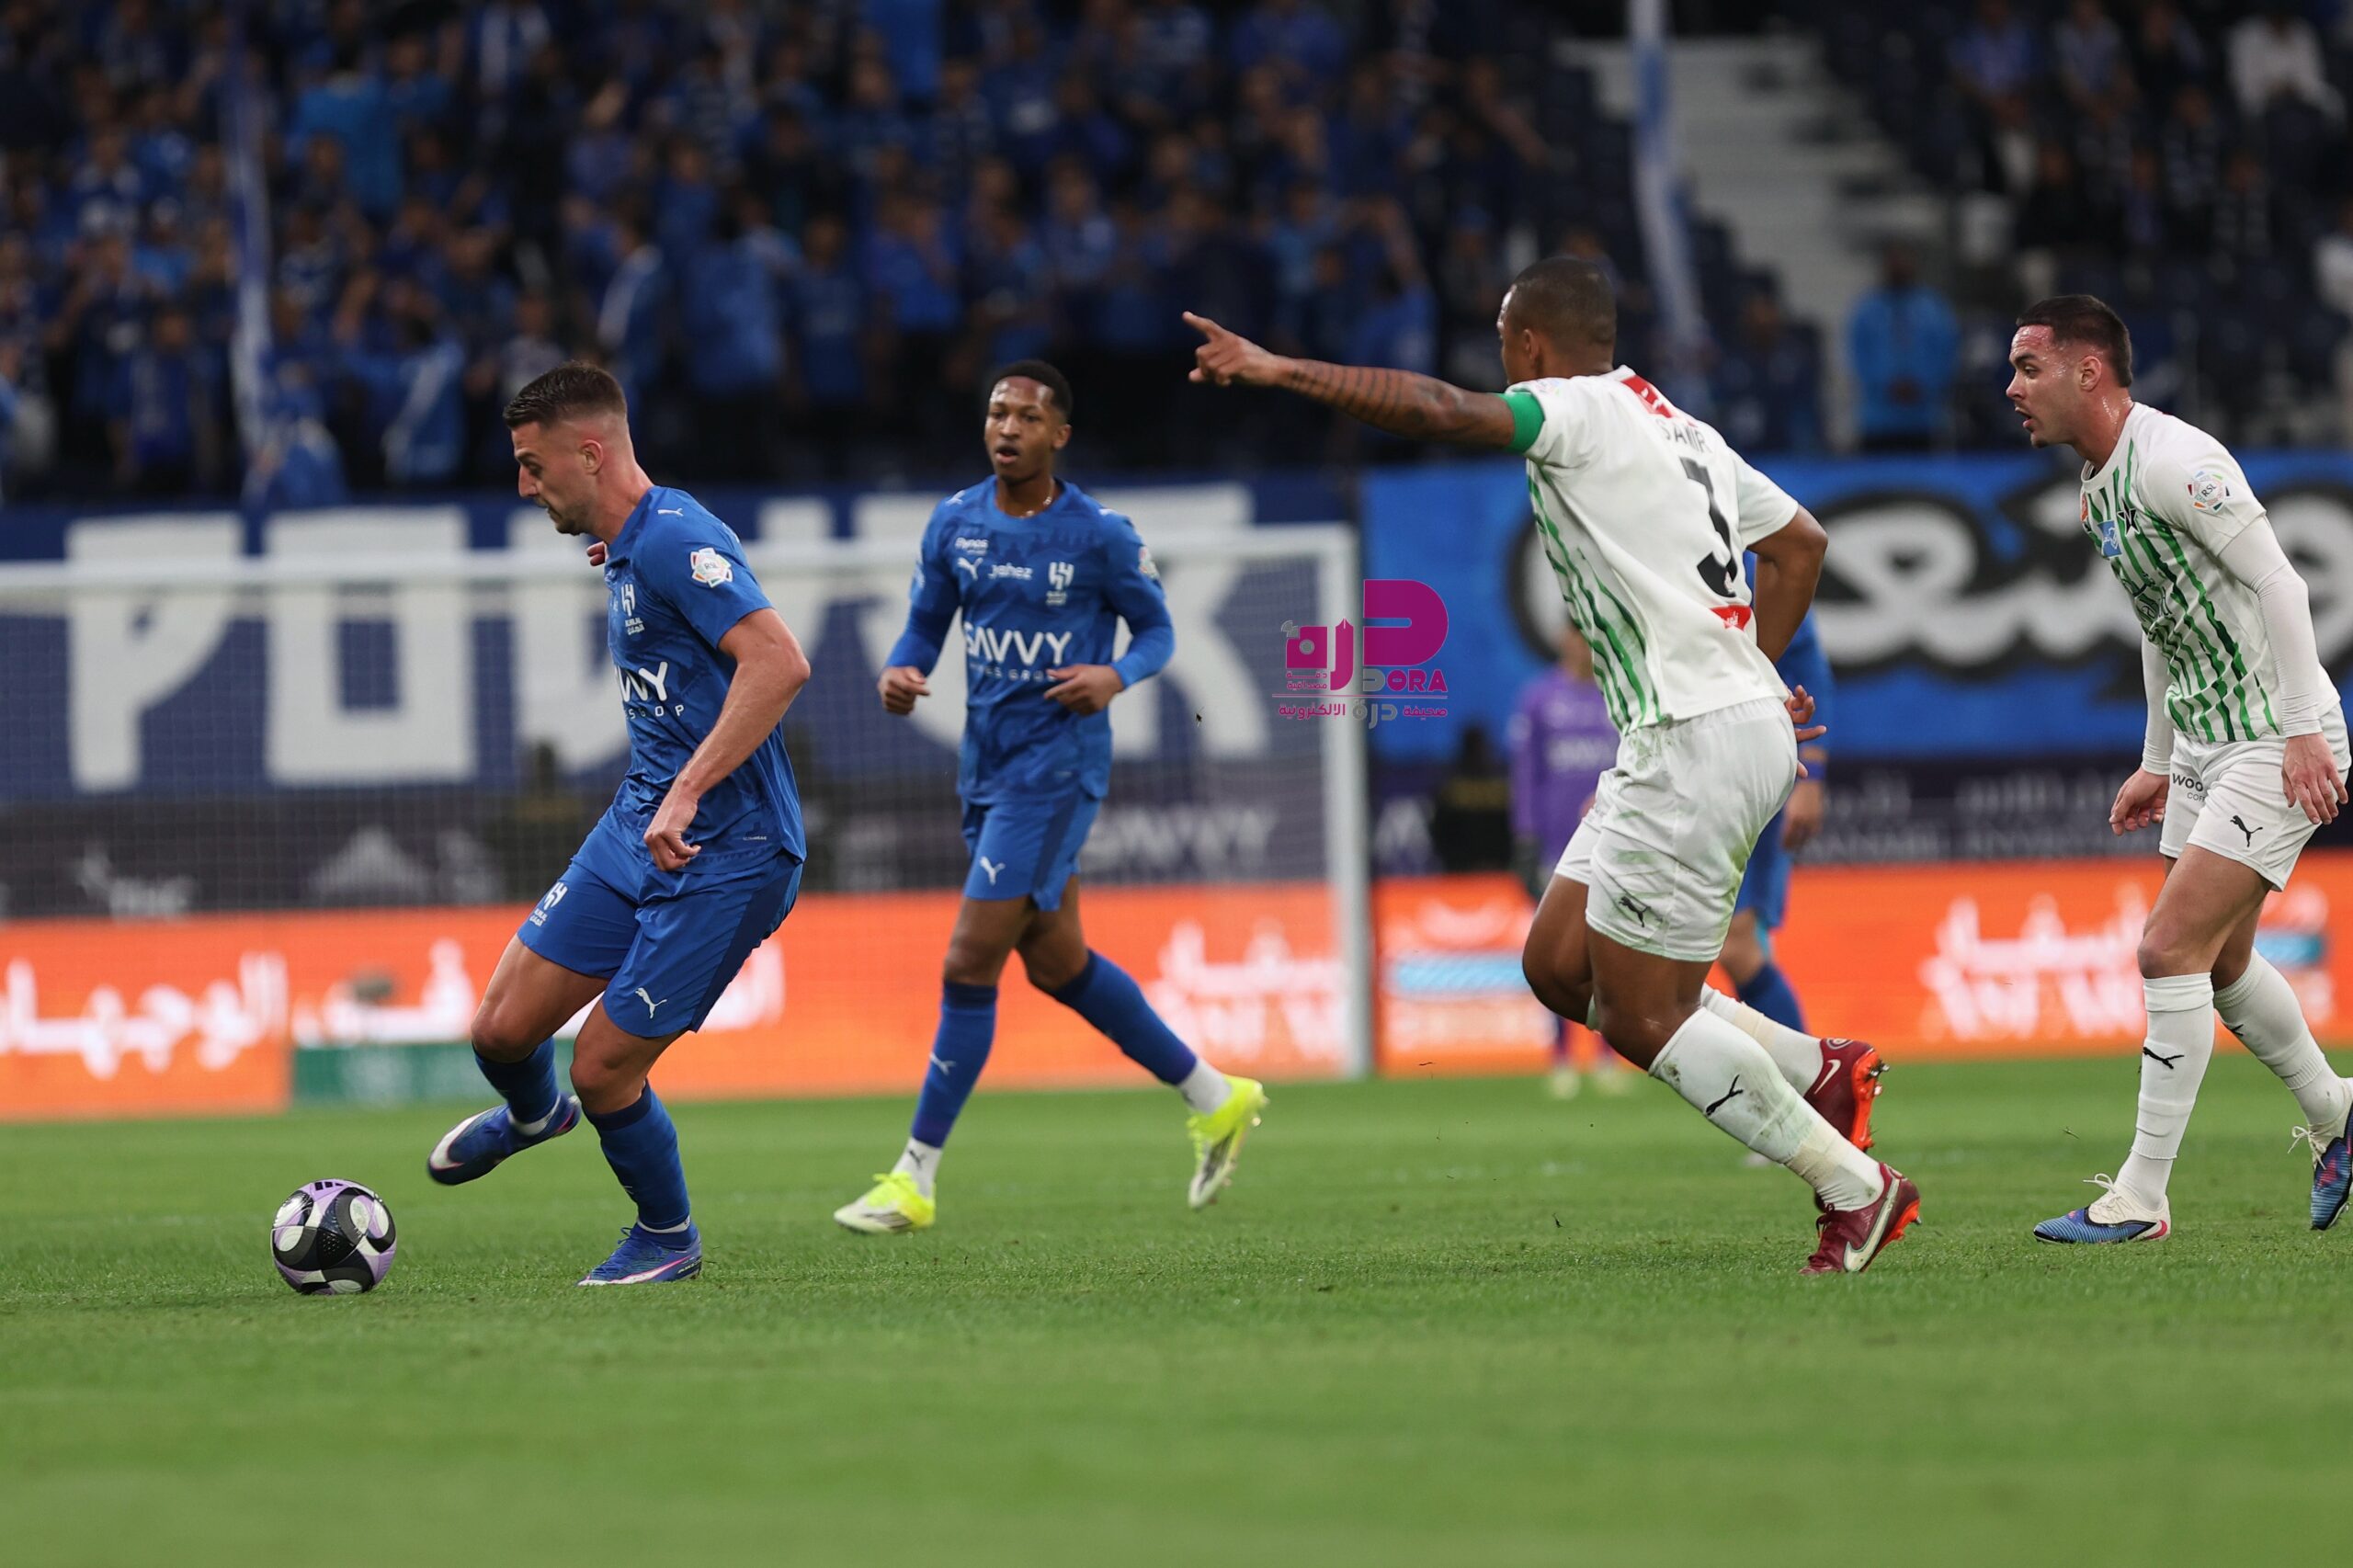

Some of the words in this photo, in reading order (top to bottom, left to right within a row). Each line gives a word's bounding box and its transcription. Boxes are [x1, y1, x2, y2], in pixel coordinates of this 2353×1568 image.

[2201, 484, 2216, 497] RSL
[988, 562, 1033, 580] jahez
[964, 621, 1072, 665] SAVVY
